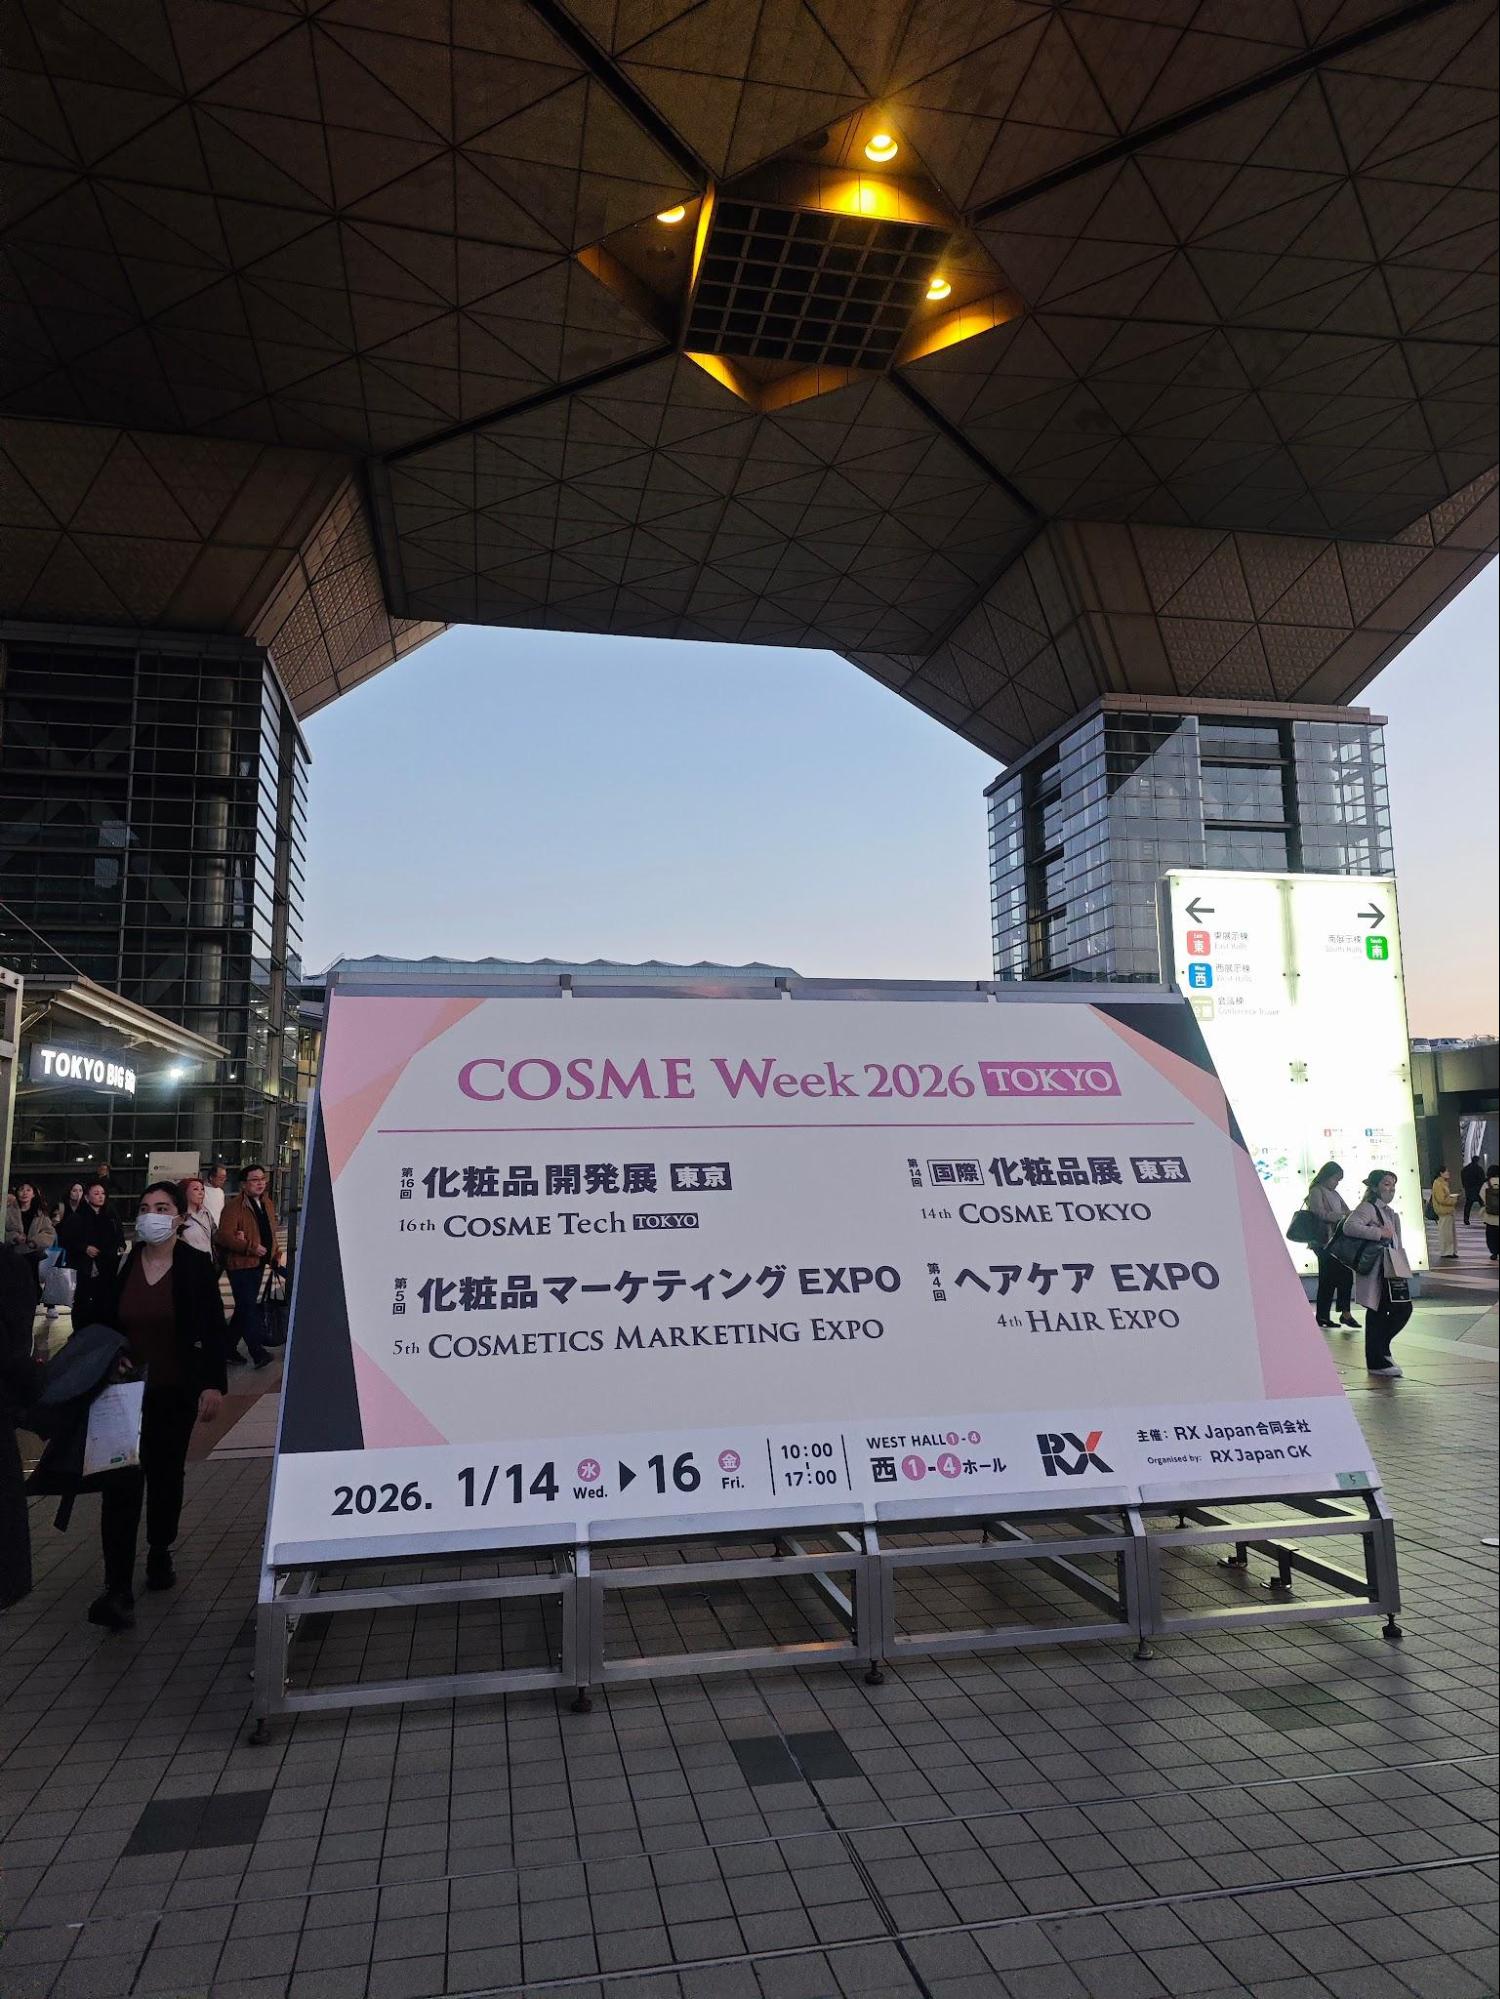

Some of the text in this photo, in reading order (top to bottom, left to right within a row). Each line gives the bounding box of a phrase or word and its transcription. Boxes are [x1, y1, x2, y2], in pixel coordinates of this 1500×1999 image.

[1194, 972, 1206, 986] 西
[41, 1049, 105, 1083] TOKYO
[106, 1063, 124, 1088] BIG
[457, 1058, 1113, 1101] COSME Week 2026 TOKYO
[400, 1167, 415, 1199] 第16回
[422, 1162, 728, 1198] 化粧品開発展 東京
[931, 1156, 1186, 1187] 国際 化粧品展 東京
[399, 1211, 698, 1237] 16th COSME Tech TOKYO
[921, 1201, 1152, 1224] 14th COSME TOKYO
[417, 1264, 901, 1314] 化粧品マーケティング EXPO
[927, 1262, 947, 1302] 第4回
[954, 1261, 1220, 1296] ヘアケア EXPO
[393, 1277, 407, 1315] 第5回
[997, 1307, 1180, 1333] 4th HAIR EXPO
[393, 1318, 884, 1359] 5th COSMETICS MARKETING EXPO
[866, 1436, 906, 1449] WEST
[1174, 1425, 1200, 1440] RX
[720, 1451, 739, 1470] 金
[781, 1443, 833, 1459] 10:00
[1036, 1431, 1115, 1477] RX
[1147, 1444, 1312, 1466] Organised by: RX Japan GK
[580, 1461, 599, 1479] 水
[721, 1476, 745, 1490] Fri.
[785, 1470, 837, 1487] 17:00
[331, 1451, 701, 1516] 2026. 1/14 16
[573, 1485, 608, 1500] Wed.
